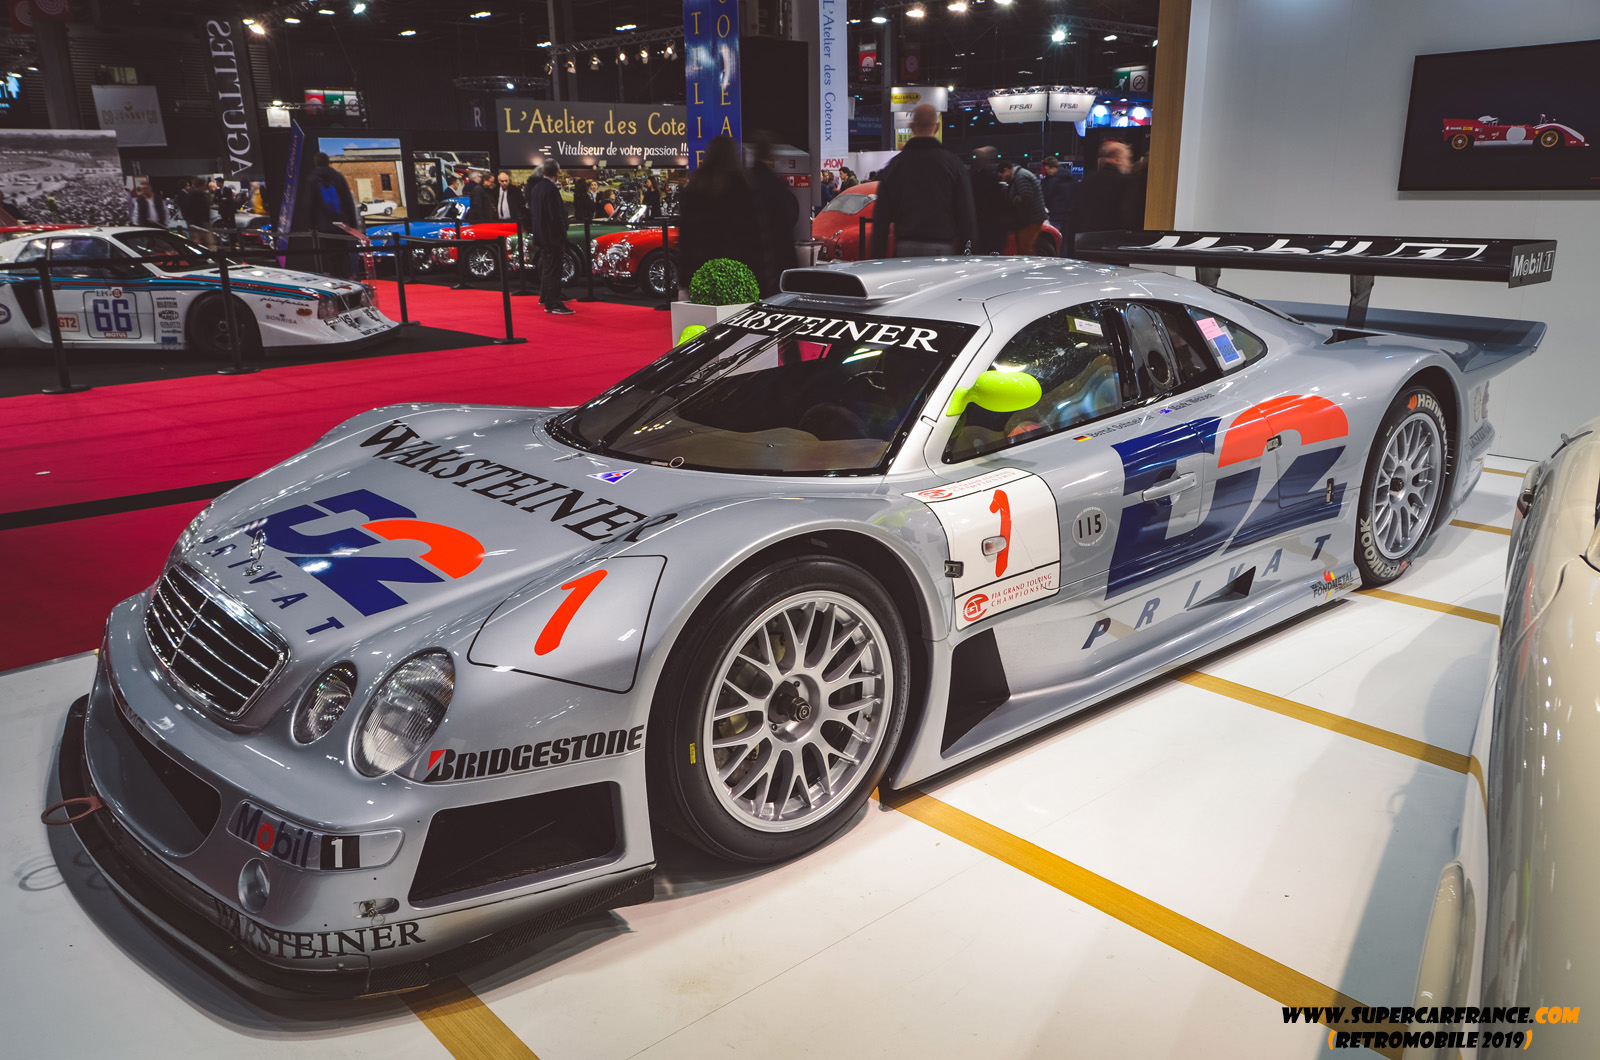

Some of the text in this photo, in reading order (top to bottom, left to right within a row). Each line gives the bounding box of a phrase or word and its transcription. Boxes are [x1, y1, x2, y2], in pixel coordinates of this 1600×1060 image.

[824, 64, 836, 86] des
[504, 107, 688, 135] L'Atelier des Cote
[824, 92, 836, 141] Coteaux
[557, 141, 604, 156] Vitaliseur
[606, 141, 617, 156] de
[619, 145, 642, 157] votre
[643, 144, 678, 160] passion
[824, 158, 844, 168] AON
[1512, 252, 1543, 278] Mobil
[58, 317, 77, 328] GT2
[93, 299, 132, 332] 66
[265, 314, 297, 325] SONRISA
[722, 309, 939, 353] ARSTEINER
[989, 489, 1012, 578] 1
[1078, 513, 1102, 538] 115
[991, 573, 1053, 600] FIA GRAND TOURING
[991, 580, 1053, 608] CHAMPIONSHIP
[1313, 571, 1354, 599] FONDMETAL
[534, 569, 608, 656] 1
[423, 724, 645, 782] BRIDGESTONE
[234, 803, 314, 869] Mobil
[213, 899, 427, 960] WARSTEINER
